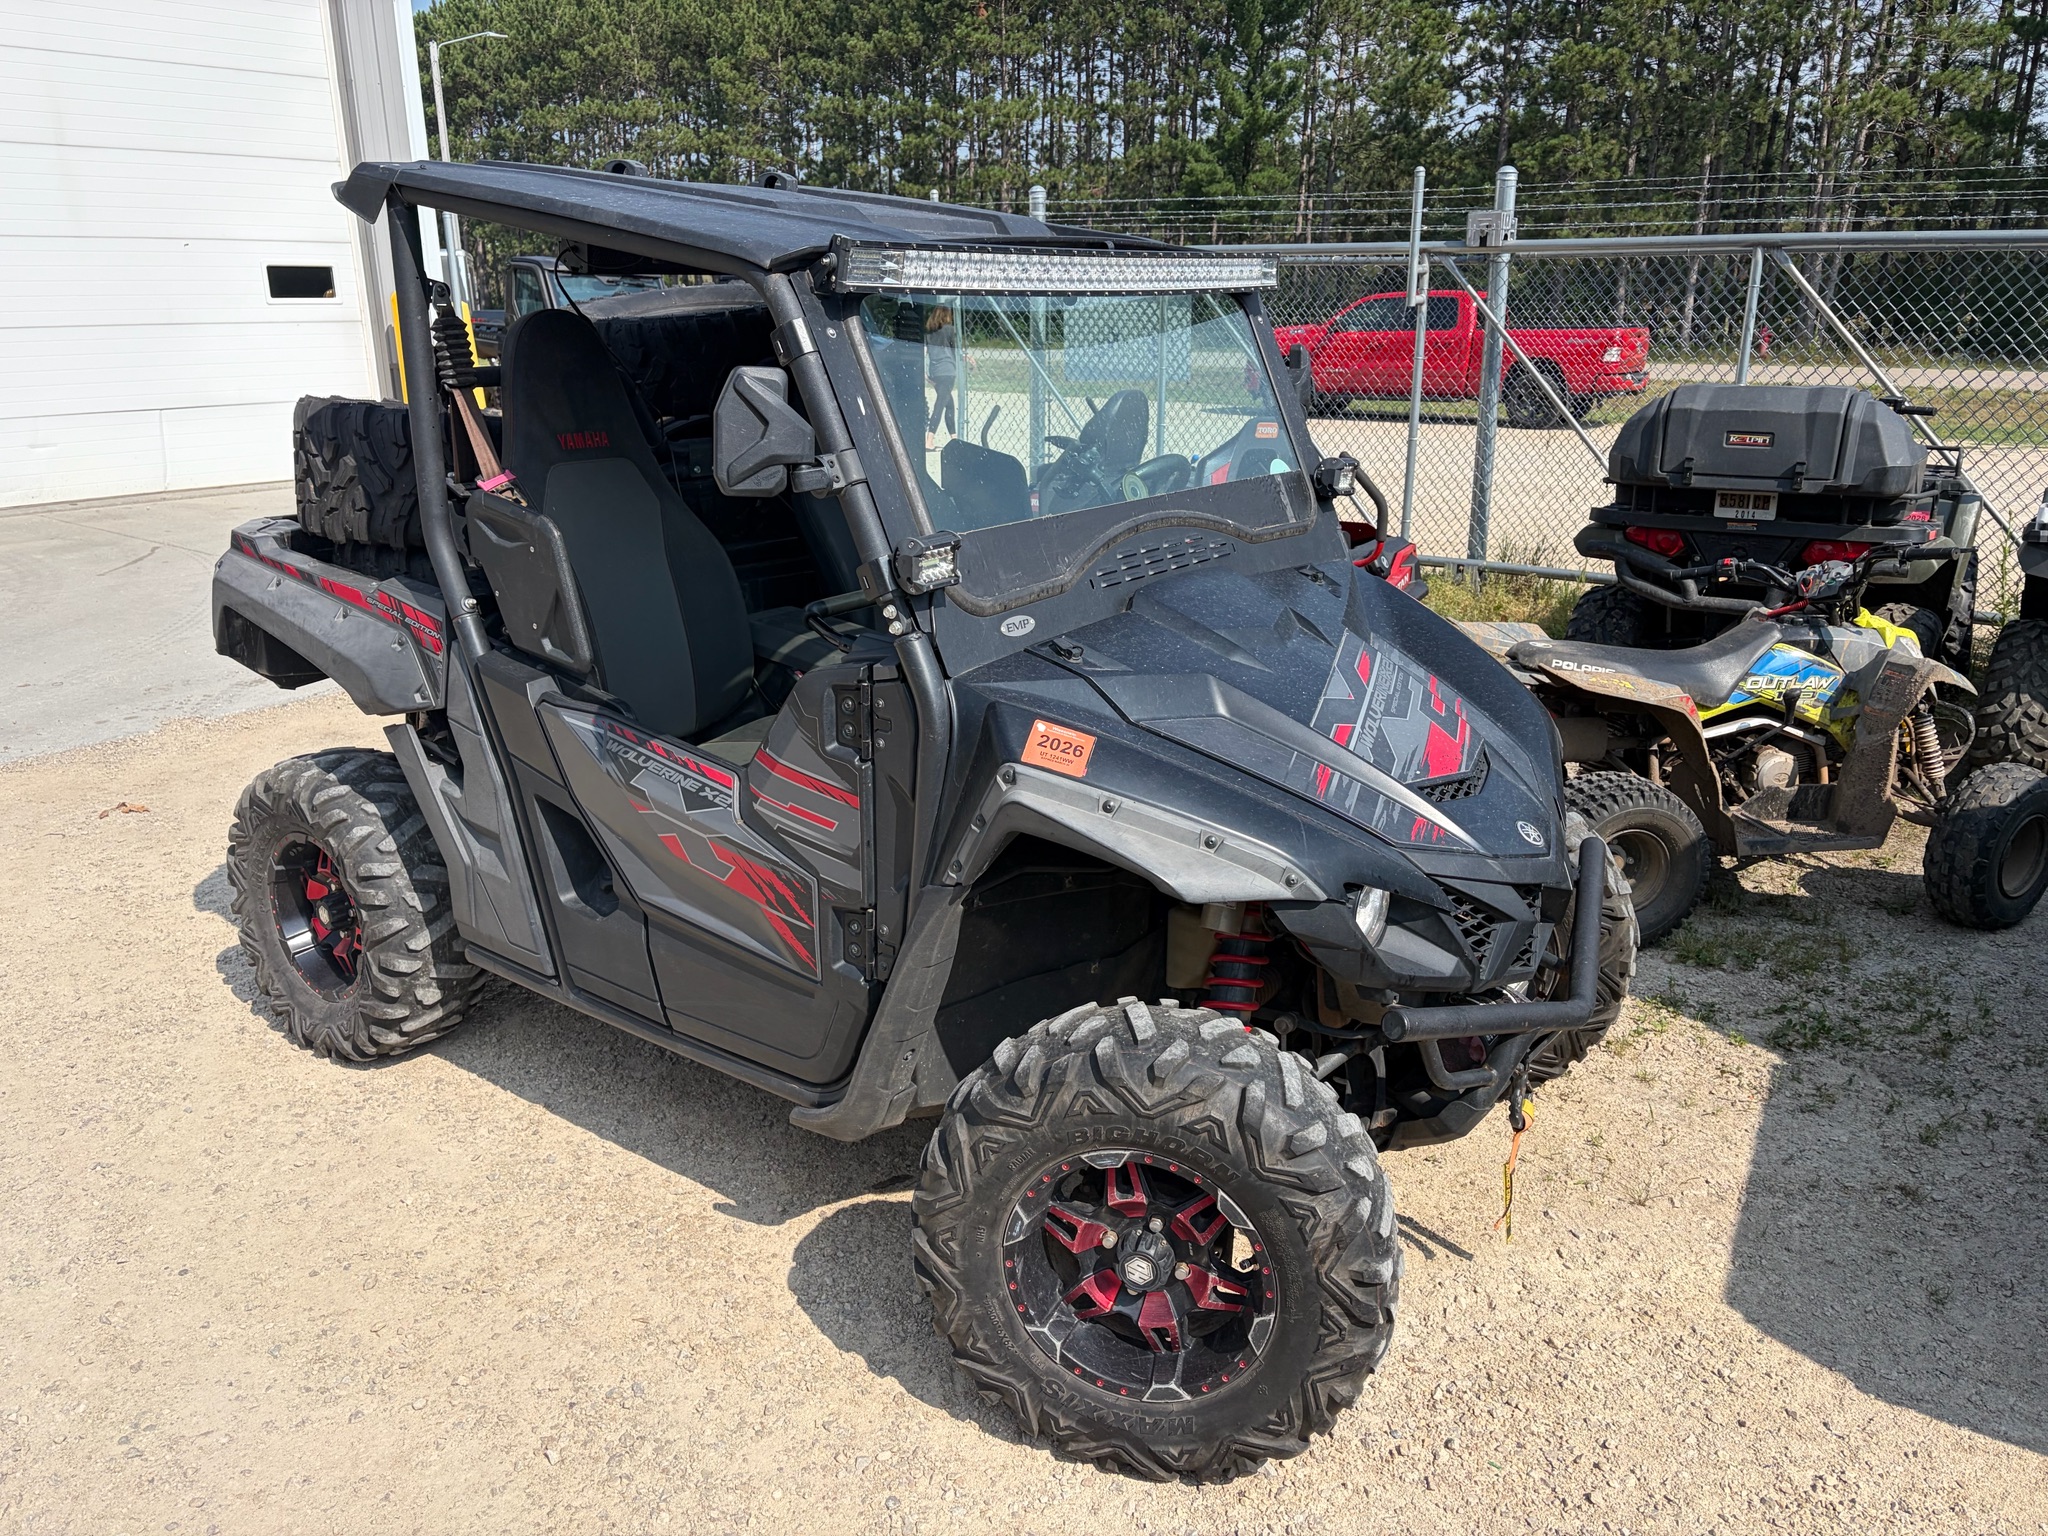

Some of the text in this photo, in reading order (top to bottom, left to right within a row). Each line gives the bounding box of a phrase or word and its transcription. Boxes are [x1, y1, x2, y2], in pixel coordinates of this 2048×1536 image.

[556, 431, 610, 451] YAMAHA
[1258, 426, 1278, 434] TORO
[1735, 509, 1756, 519] 2014
[366, 596, 440, 638] SPECIAL EDITION
[1006, 618, 1030, 633] EMP
[1746, 674, 1839, 690] OUTLAW
[1360, 672, 1392, 749] WOLVERINE
[1036, 734, 1085, 758] 2026
[1049, 753, 1075, 765] 1241WW
[605, 739, 733, 808] WOLVERINE X2
[1007, 1147, 1036, 1172] RADIAL
[1066, 1125, 1242, 1183] BIGHORN
[976, 1225, 986, 1243] NHS
[1040, 1377, 1196, 1437] MAXXIS
